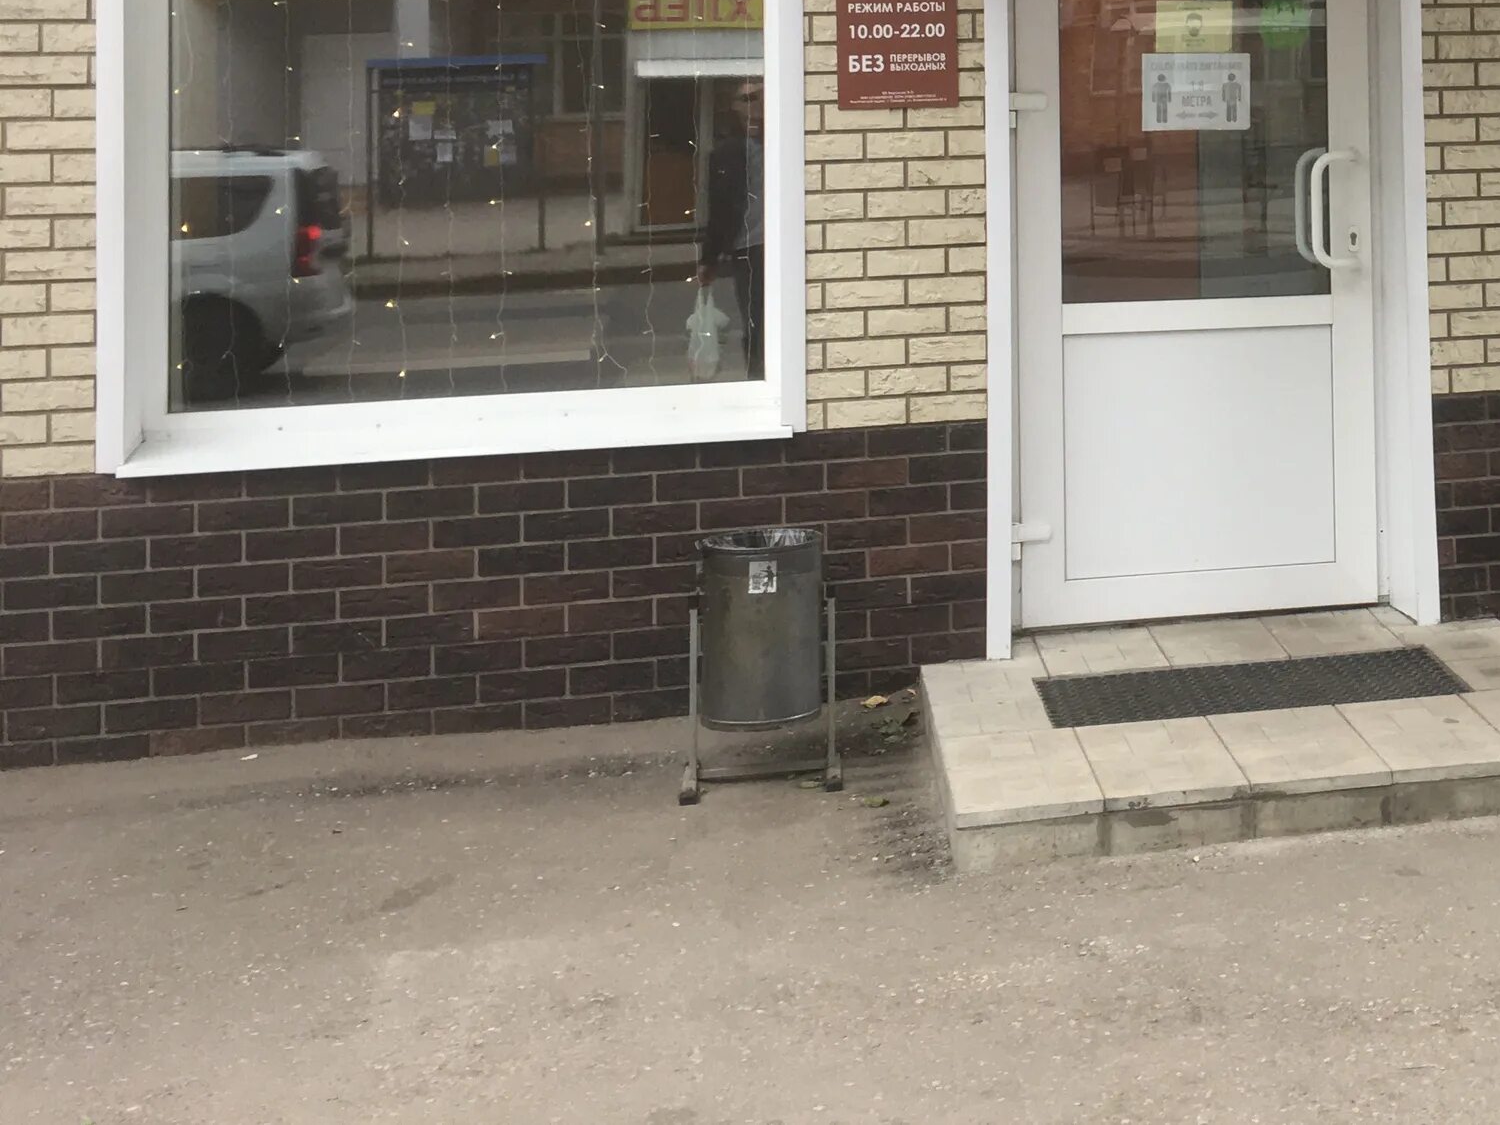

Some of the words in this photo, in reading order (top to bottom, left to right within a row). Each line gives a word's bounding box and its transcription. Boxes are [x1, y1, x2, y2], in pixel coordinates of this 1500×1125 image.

[847, 2, 894, 14] РЕЖИМ
[896, 1, 946, 13] РАБОТЫ
[848, 22, 946, 39] 10.00-22.00
[848, 53, 885, 73] БЕЗ
[889, 52, 946, 63] ПЕРЕРЫВОВ
[889, 62, 946, 72] ВЫХОДНЫХ
